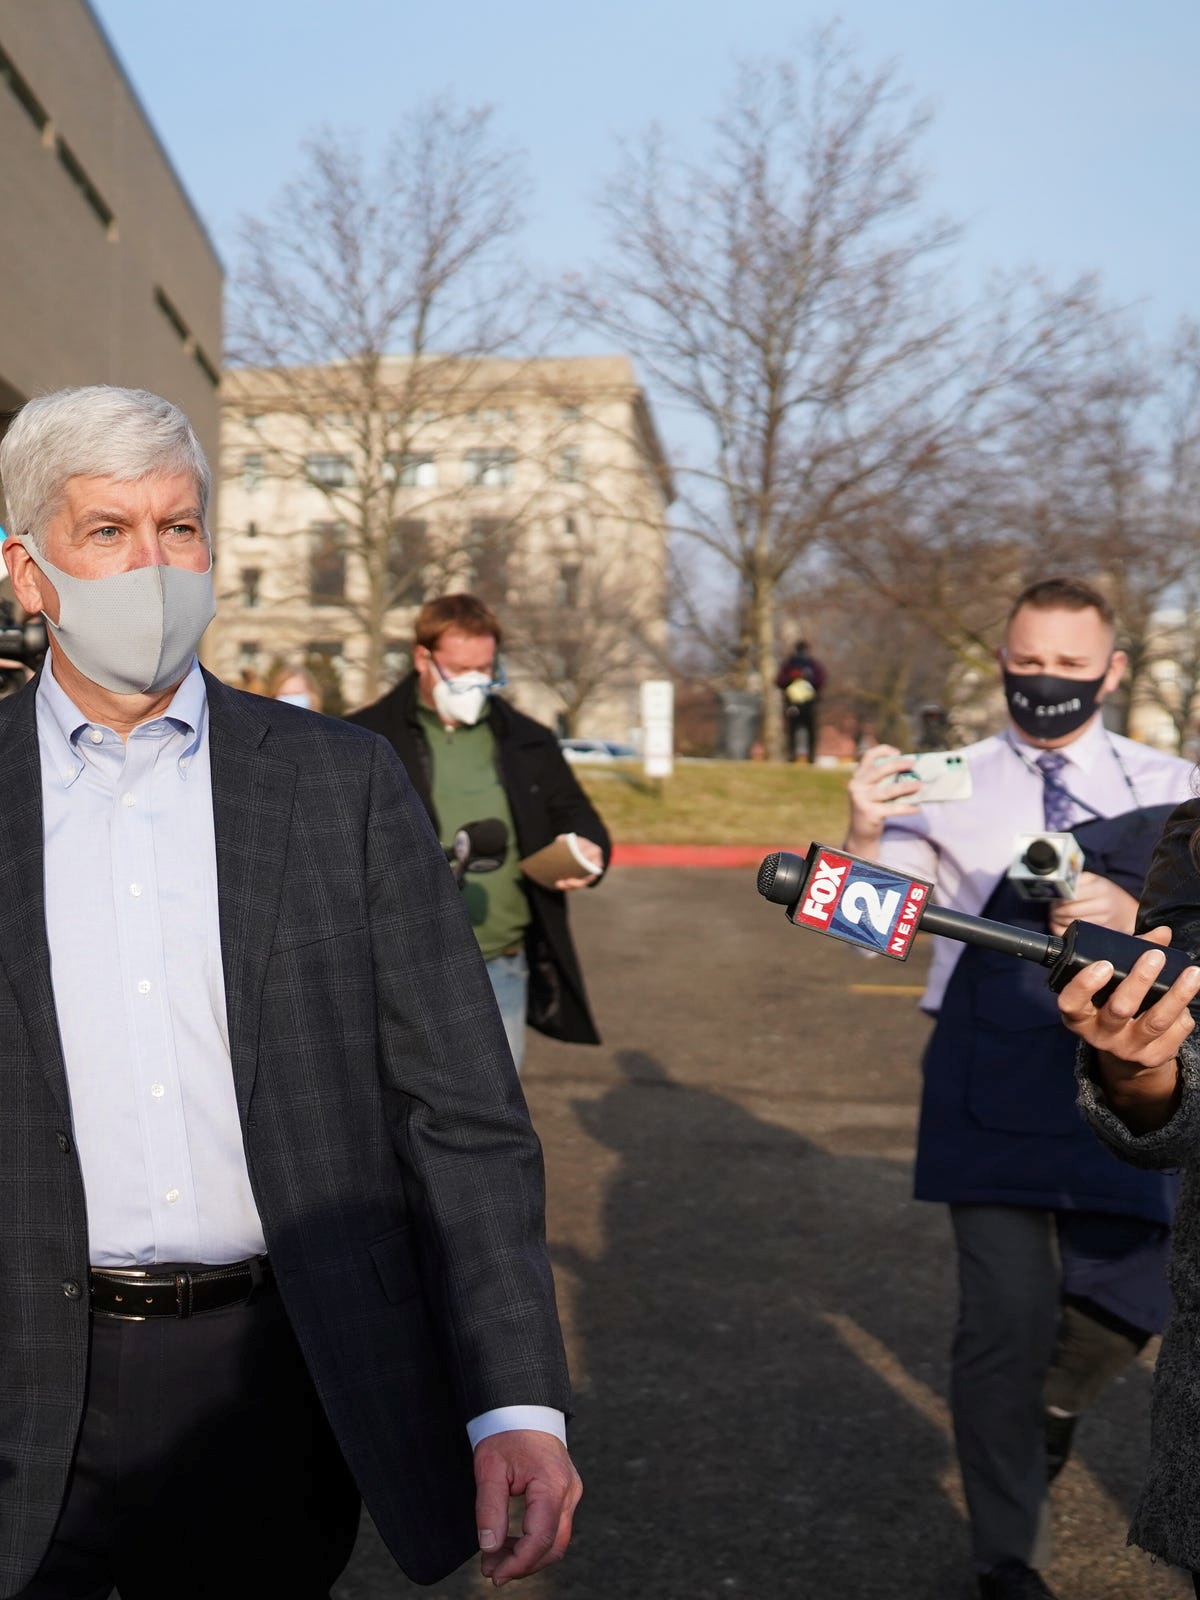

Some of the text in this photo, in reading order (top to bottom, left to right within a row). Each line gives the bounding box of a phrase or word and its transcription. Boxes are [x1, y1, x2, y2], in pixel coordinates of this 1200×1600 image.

[802, 860, 846, 921] FOX
[841, 881, 901, 935] 2
[892, 887, 924, 952] NEWS
